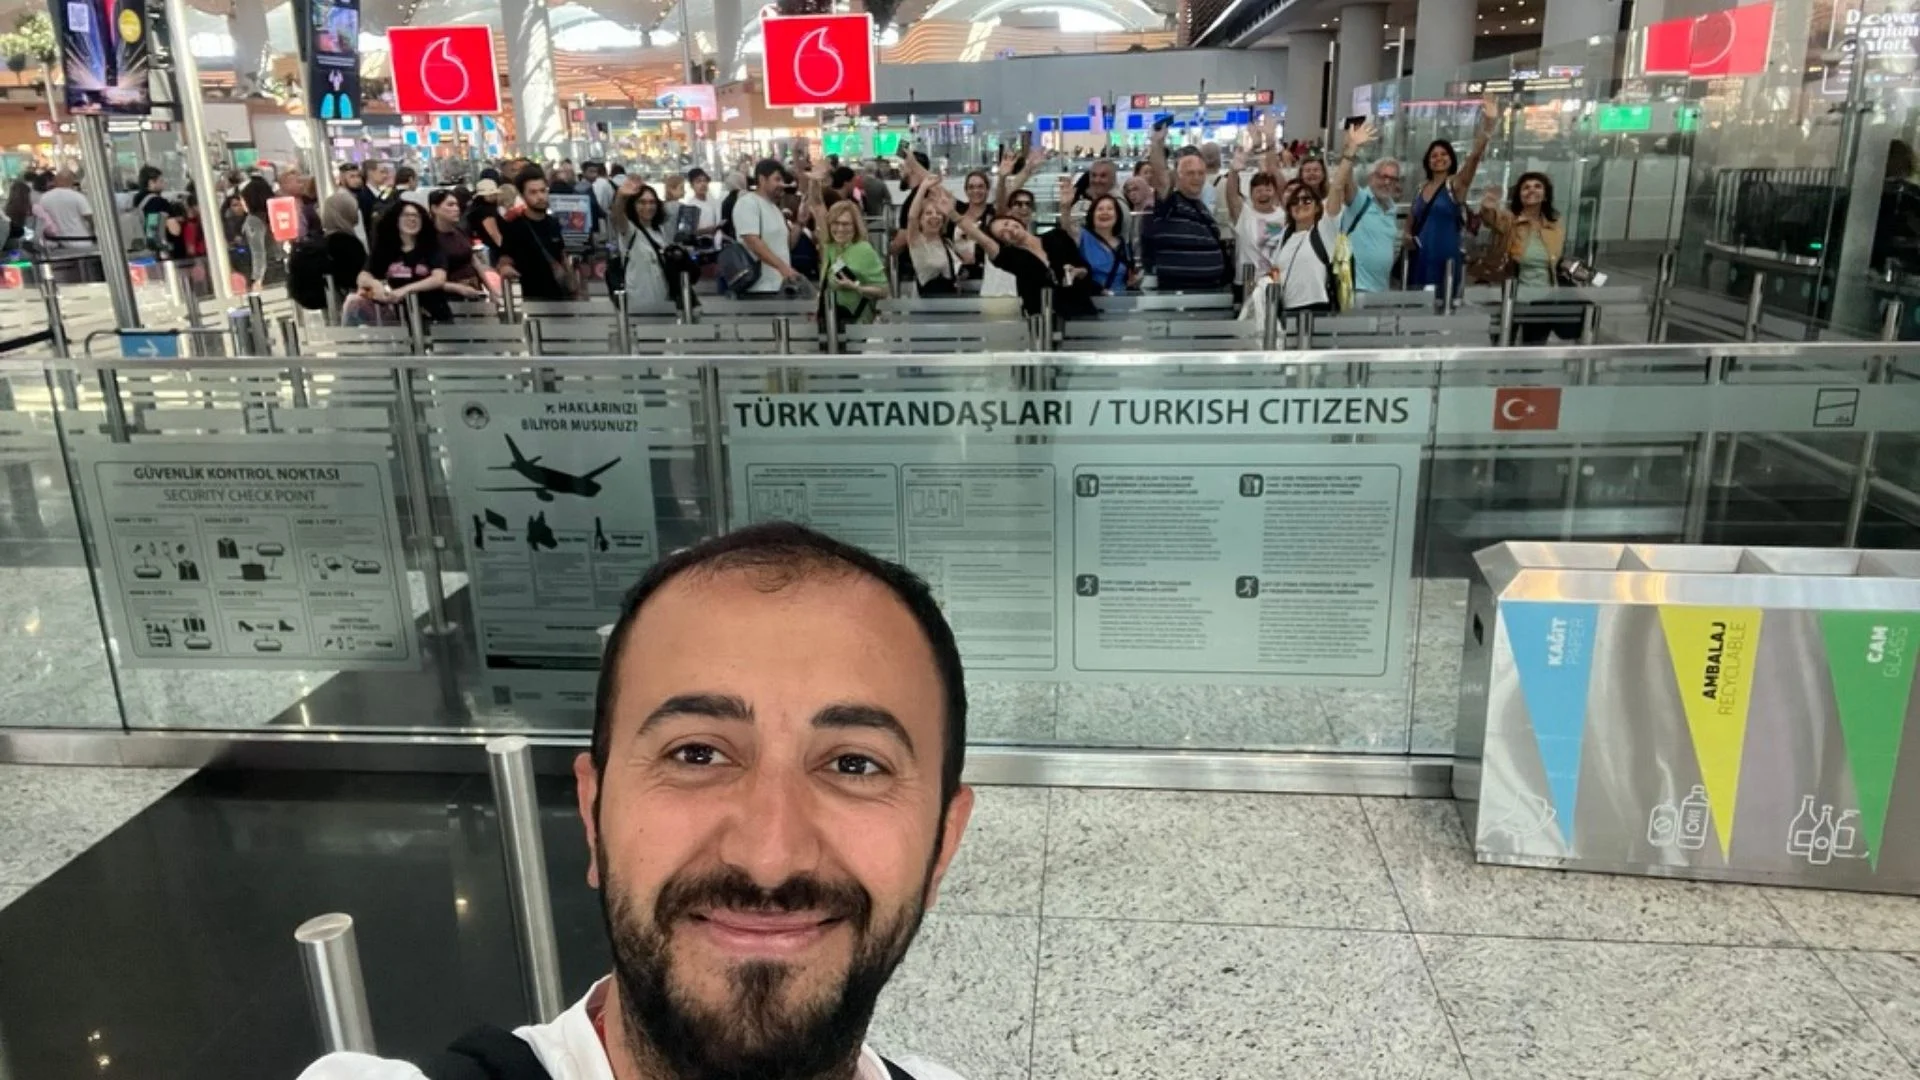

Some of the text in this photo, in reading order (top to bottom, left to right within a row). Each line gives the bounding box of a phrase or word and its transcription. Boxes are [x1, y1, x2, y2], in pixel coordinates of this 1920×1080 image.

[558, 401, 638, 414] HAKLARINIZI
[571, 419, 638, 432] MUSUNUZ?
[734, 396, 1410, 432] TÜRK VATANDAŞLARI / TURKISH CITIZENS
[133, 465, 340, 481] GÜVENLİK KONTROL NOKTASI
[163, 488, 316, 502] SECURITY CHECK POINT
[1546, 616, 1567, 666] KAĞIT
[1866, 625, 1888, 663] CAM
[1882, 626, 1909, 678] GLASS
[1702, 621, 1726, 701] AMBALAJ
[1717, 622, 1746, 716] RECYCLABLE
